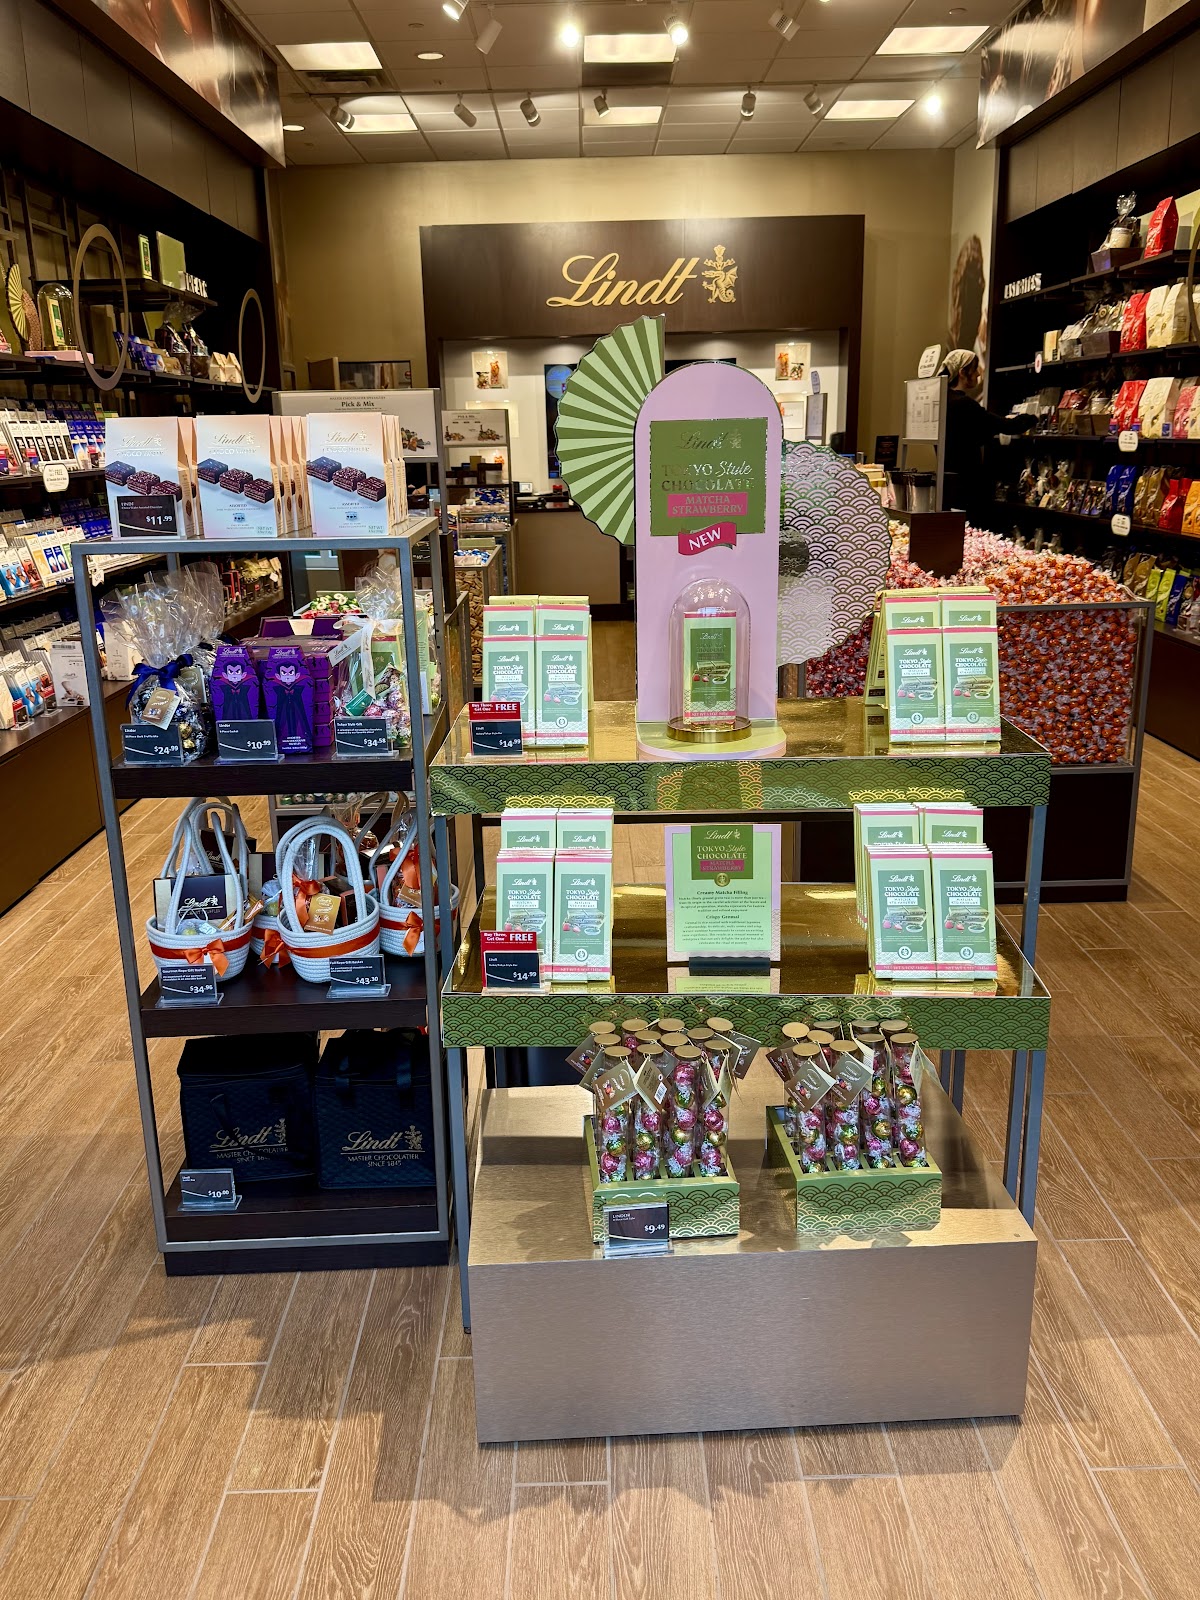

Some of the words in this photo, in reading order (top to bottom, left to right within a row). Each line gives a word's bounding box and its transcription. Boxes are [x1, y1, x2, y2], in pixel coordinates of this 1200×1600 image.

[546, 252, 700, 307] Lindt
[715, 460, 752, 478] Style
[685, 495, 731, 505] MATCHA
[672, 504, 744, 515] STRAWBERRY
[146, 515, 173, 525] $11.99
[688, 527, 721, 551] NEW
[495, 703, 518, 711] FREE
[247, 740, 271, 750] $10.99
[499, 738, 521, 748] $14.99
[154, 745, 179, 755] $24.99
[704, 829, 734, 840] Lindt
[696, 845, 725, 853] TOKYO
[726, 844, 746, 854] Style
[696, 852, 748, 860] CHOCOLATE
[510, 933, 534, 942] FREE
[356, 976, 379, 985] $43.30
[513, 971, 537, 981] $14.99
[210, 1126, 272, 1149] Lindt
[341, 1130, 403, 1151] Lindt
[217, 1151, 242, 1160] MASTER
[374, 1153, 420, 1161] CHOCOLATIER
[367, 1160, 386, 1168] SINCE
[644, 1223, 666, 1234] $9.49
